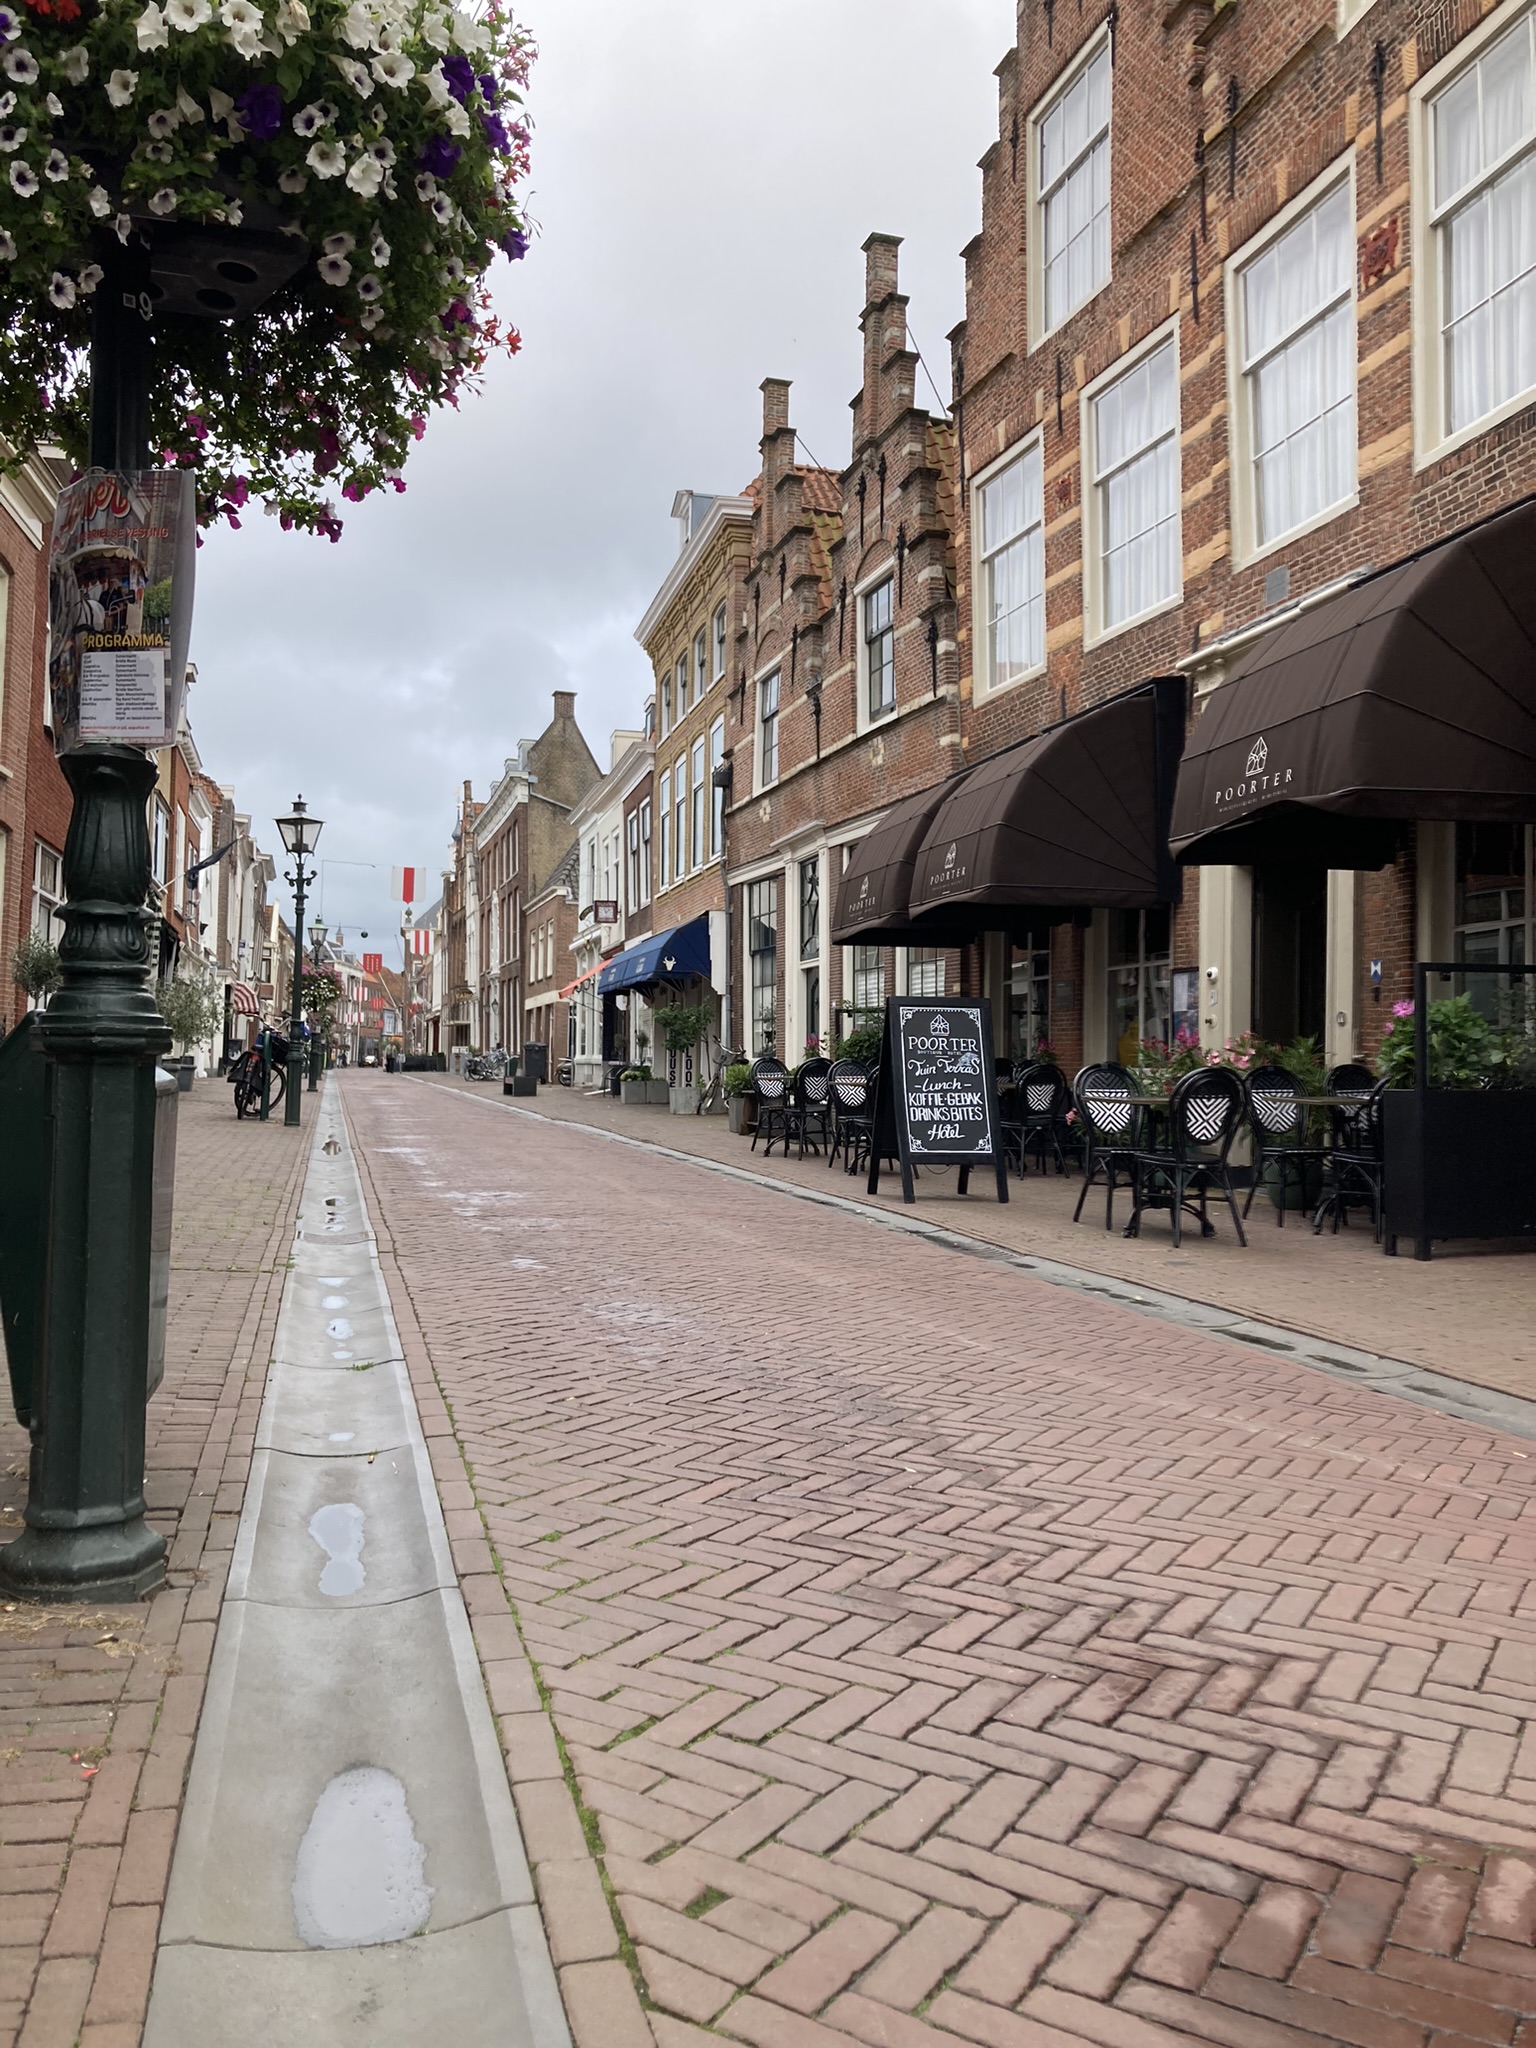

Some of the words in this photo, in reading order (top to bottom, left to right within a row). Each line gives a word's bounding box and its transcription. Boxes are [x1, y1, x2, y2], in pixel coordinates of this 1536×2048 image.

[83, 633, 164, 648] PROGRAMMA
[1215, 768, 1293, 804] POORTER
[930, 866, 966, 885] POORTER
[908, 1036, 979, 1052] POORTER
[907, 1059, 937, 1077] Tuin
[910, 1107, 950, 1121] DRINKS
[950, 1106, 983, 1121] BITES
